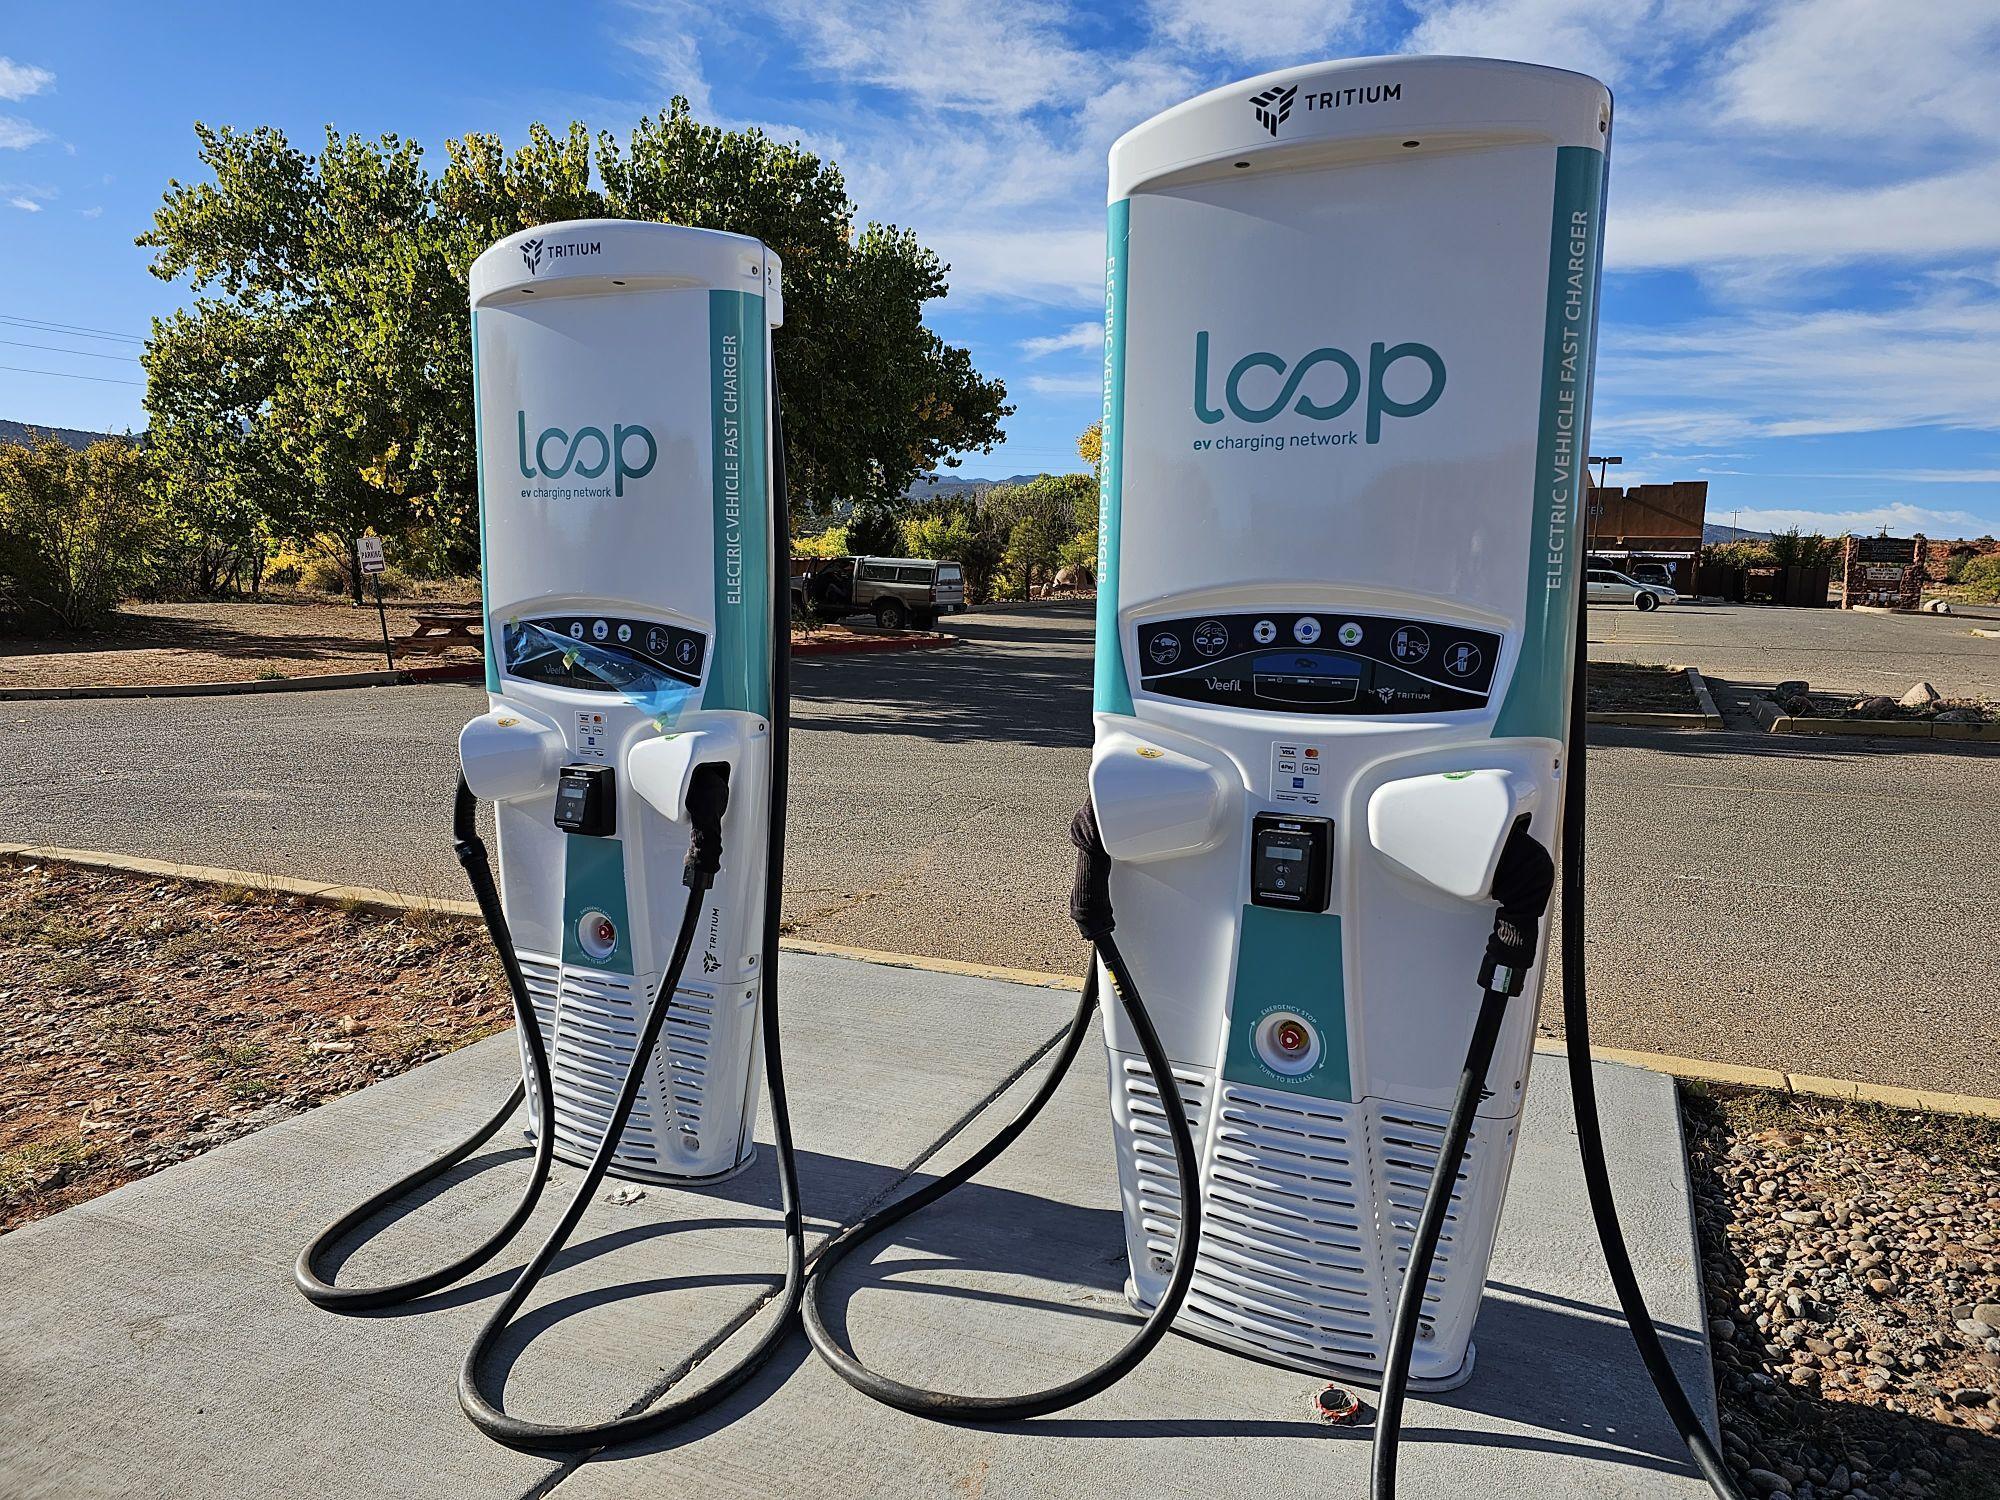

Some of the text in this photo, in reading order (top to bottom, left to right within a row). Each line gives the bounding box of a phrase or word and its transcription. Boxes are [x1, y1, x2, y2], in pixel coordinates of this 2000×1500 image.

[1304, 83, 1402, 111] TRITIUM
[547, 241, 601, 258] TRITIUM
[1194, 330, 1447, 445] loop
[1547, 210, 1588, 590] ELECTRIC VEHICLE FAST CHARGER
[1097, 256, 1115, 583] ELECTRIC VEHICLE FAST CHARGER
[518, 410, 657, 497] loop
[1193, 431, 1358, 452] ev charging network
[722, 334, 741, 604] ELECTRIC VEHICLE FAST CHARGER
[521, 487, 612, 500] ev charging network
[1205, 677, 1242, 692] Veefil
[1397, 691, 1431, 700] TRITIUM
[709, 907, 720, 950] TRITIUM
[1261, 1004, 1317, 1024] EMERGENCY STOP
[1259, 1063, 1315, 1084] TURN TO RELEASE
